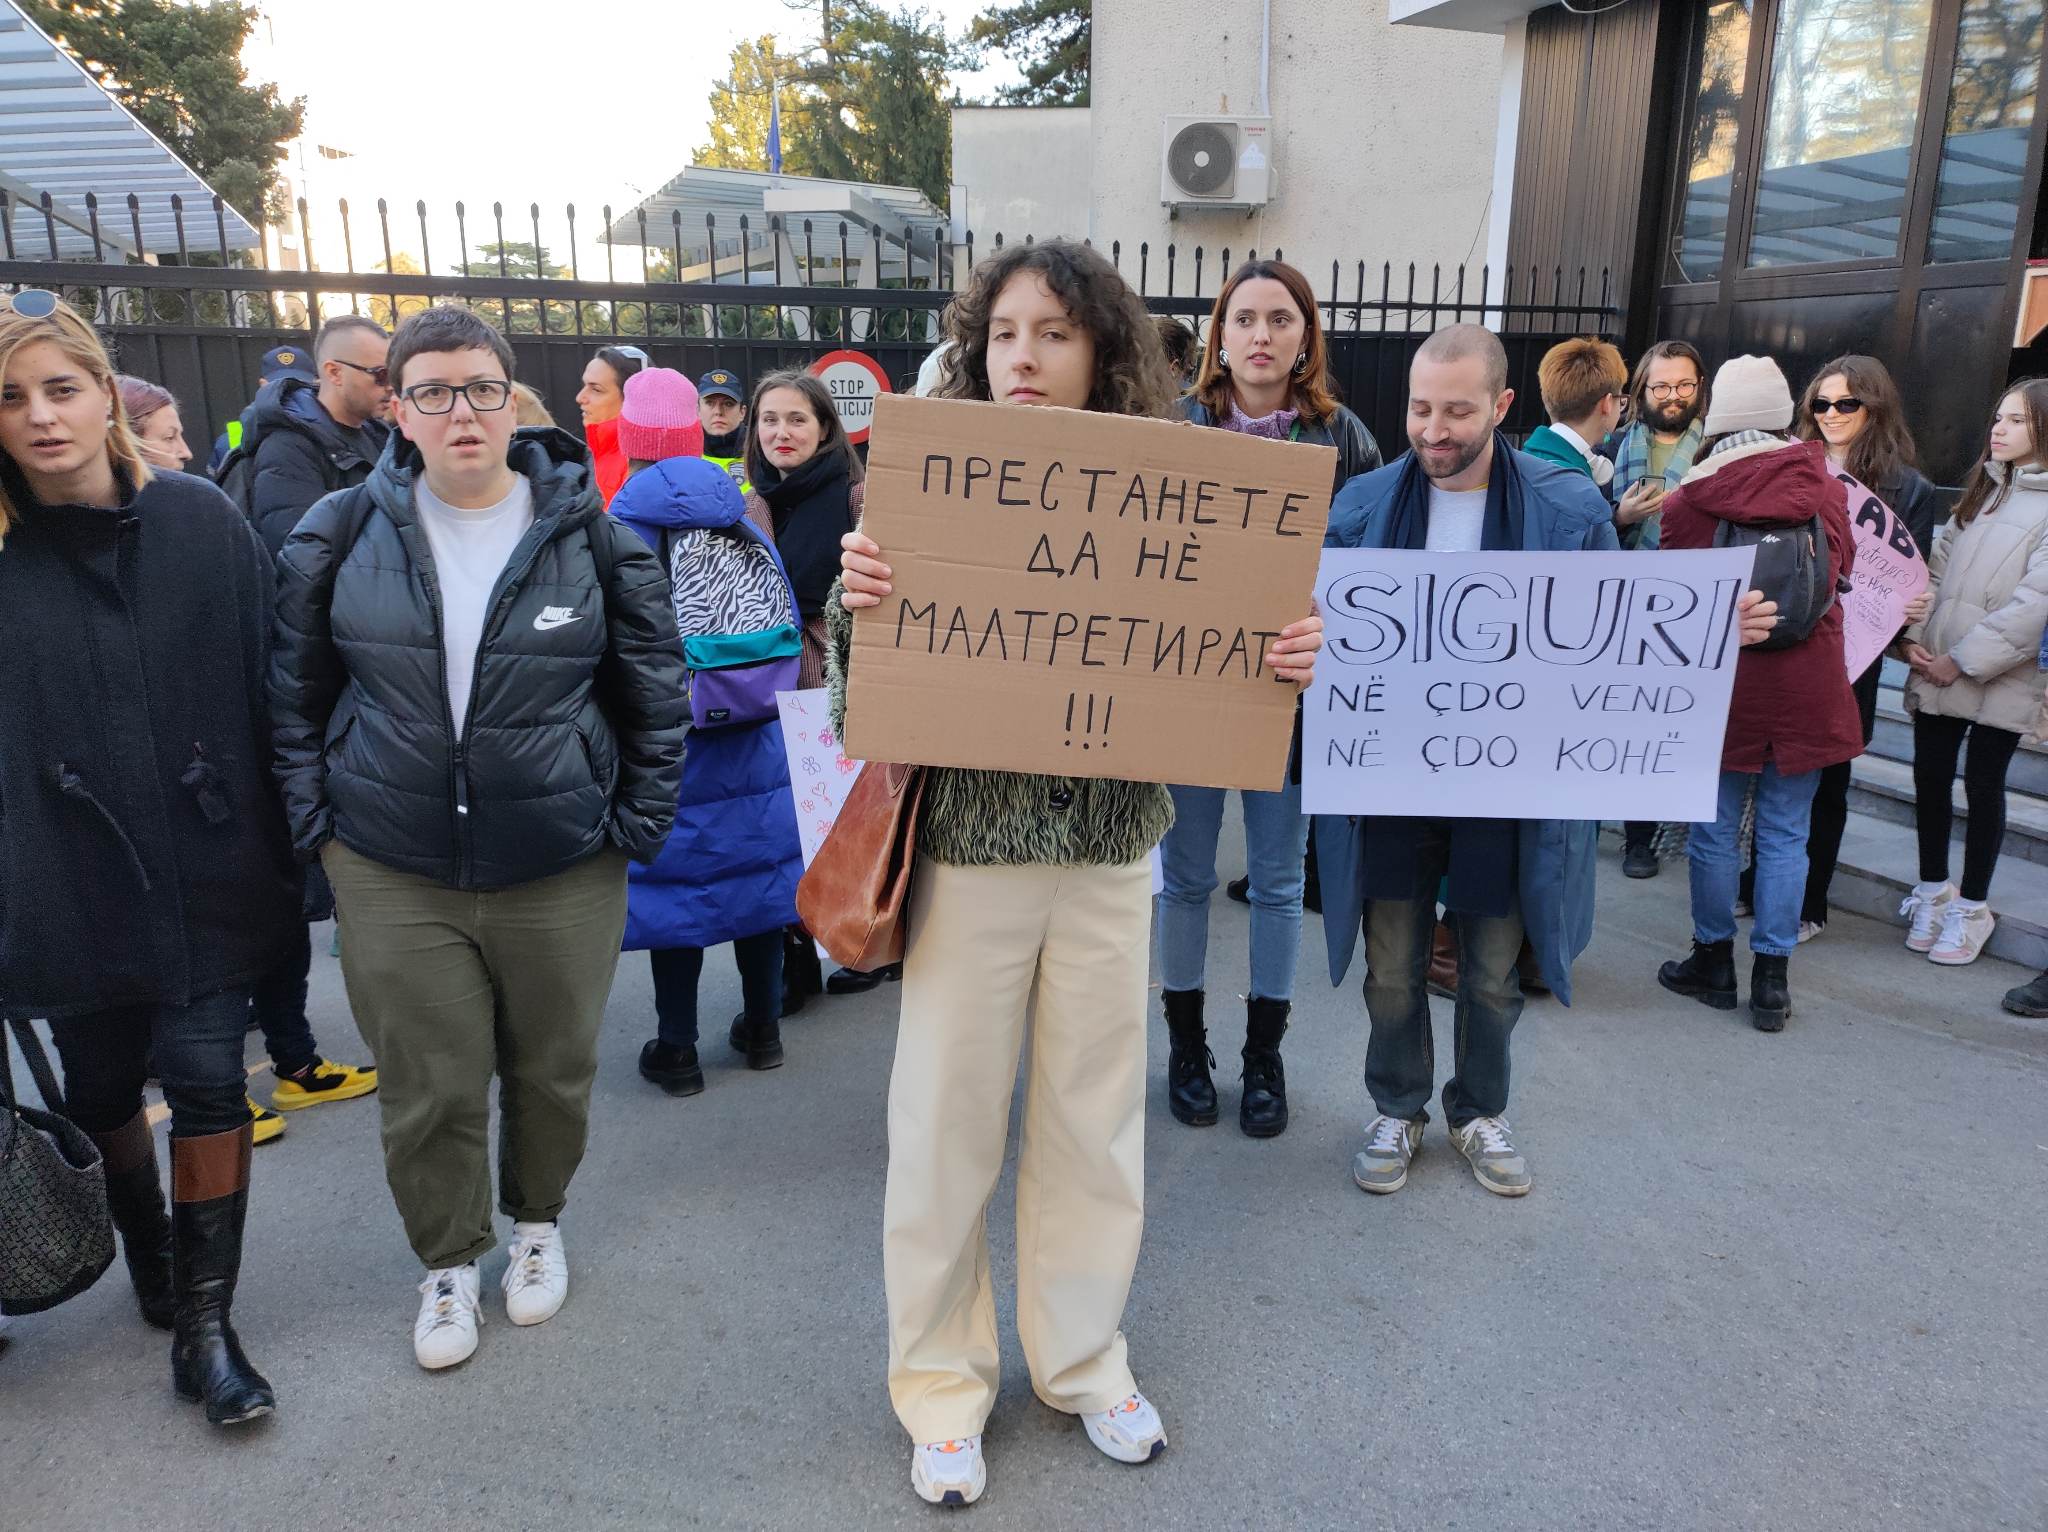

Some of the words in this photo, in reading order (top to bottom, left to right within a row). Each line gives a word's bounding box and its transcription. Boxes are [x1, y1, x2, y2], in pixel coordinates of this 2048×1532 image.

[830, 379, 864, 395] STOP
[923, 454, 1310, 537] ПРЕСТАНЕТЕ
[1026, 530, 1100, 580] ДА
[542, 606, 575, 620] NIKE
[1325, 570, 1742, 670] SIGURI
[896, 598, 1294, 684] МАЛТРЕТИРАТ
[1327, 675, 1386, 712] NË
[1425, 682, 1525, 717] ÇDO
[1571, 684, 1695, 714] VEND
[1064, 693, 1113, 750] !!!
[1327, 730, 1385, 768] NË
[1421, 735, 1518, 773] ÇDO
[1555, 731, 1685, 775] KOHË
